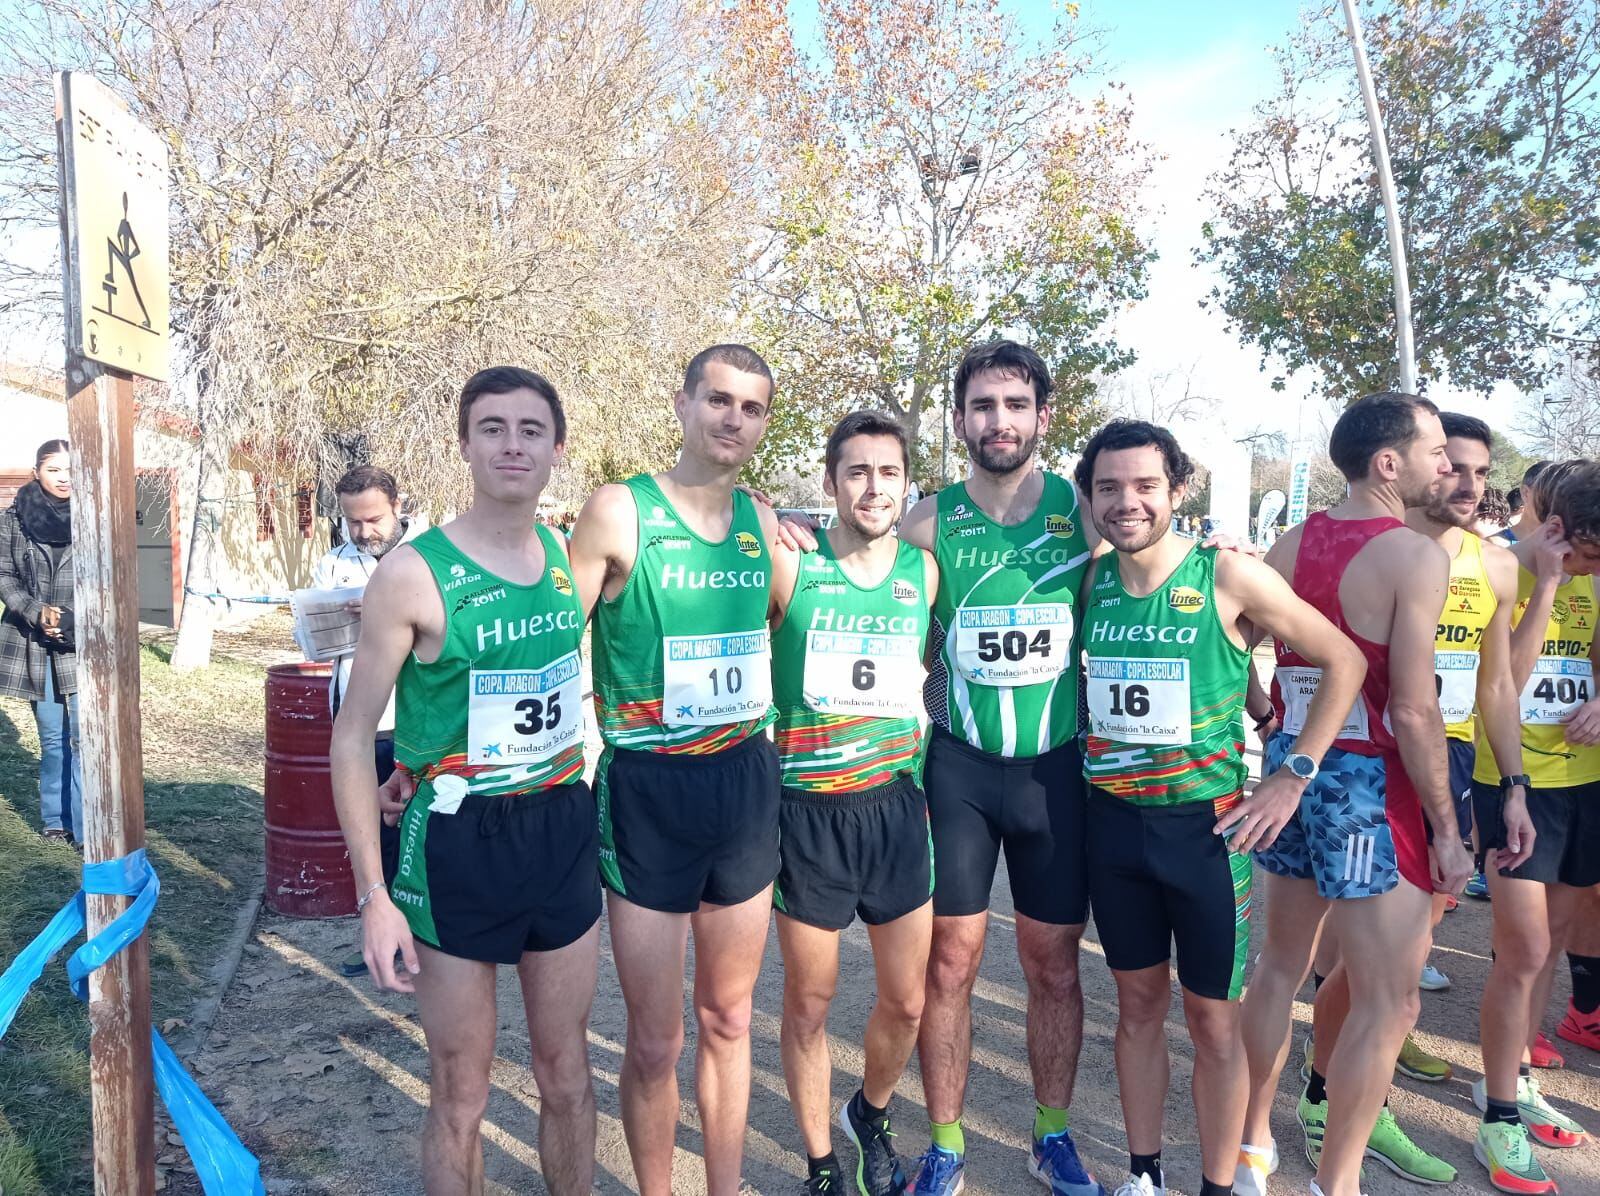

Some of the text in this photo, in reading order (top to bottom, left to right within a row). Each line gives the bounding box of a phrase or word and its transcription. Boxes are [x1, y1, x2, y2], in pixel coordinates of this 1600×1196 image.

[946, 512, 974, 522] VIATOR
[960, 526, 986, 537] ZOITI
[955, 547, 1068, 569] Huesca
[444, 574, 482, 592] VIATOR
[661, 563, 765, 590] Huesca
[472, 588, 507, 607] ZOITI
[810, 607, 918, 633] Huesca
[962, 611, 980, 627] COPA
[981, 609, 1010, 627] ARAGON
[1016, 608, 1035, 625] COPA
[476, 610, 580, 653] Huesca
[1091, 620, 1198, 644] Huesca
[1435, 624, 1483, 645] PIO-7
[672, 640, 694, 660] COPA
[727, 636, 745, 656] COPA
[978, 629, 1052, 662] 504
[709, 666, 742, 697] 10
[852, 659, 876, 691] 6
[1127, 662, 1147, 679] COPA
[1148, 663, 1182, 680] ESCOLAR
[479, 674, 503, 693] COPA
[504, 674, 541, 692] ARAGON
[1533, 677, 1589, 704] 404
[1109, 683, 1150, 717] 16
[514, 691, 561, 736] 35
[1151, 725, 1179, 735] Caixa"
[401, 808, 422, 877] Huesca
[393, 888, 423, 907] ZOITI
